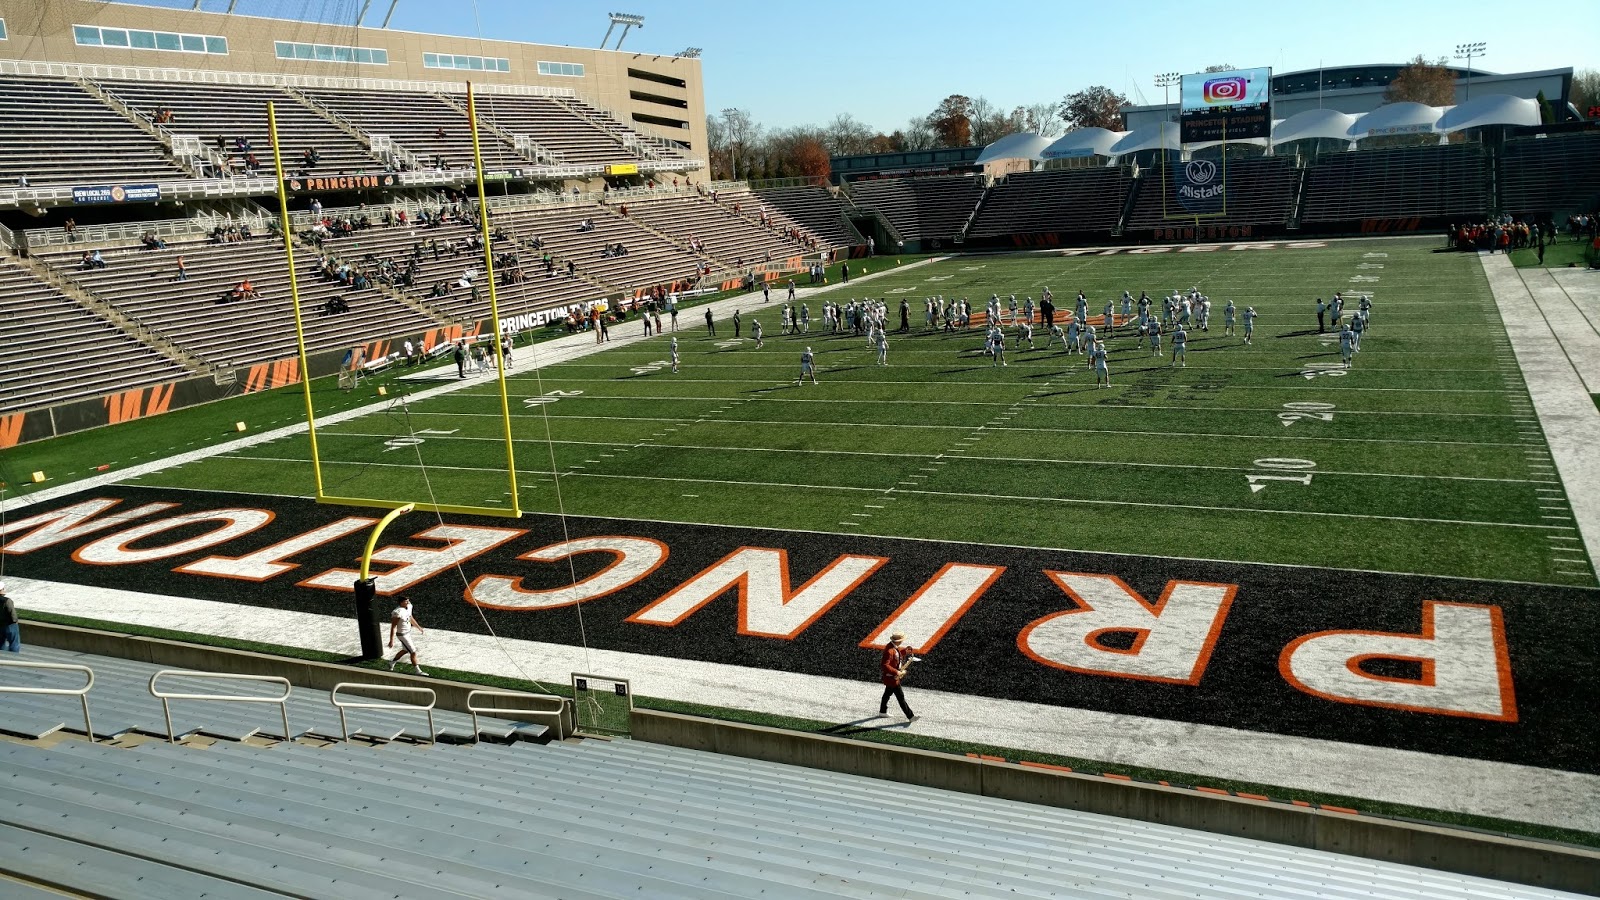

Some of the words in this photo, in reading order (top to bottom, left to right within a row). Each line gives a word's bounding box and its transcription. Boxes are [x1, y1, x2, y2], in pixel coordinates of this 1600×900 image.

[1230, 115, 1265, 125] STADIUM
[306, 175, 379, 190] PRINCETON
[1179, 184, 1224, 199] Allstate
[1153, 225, 1252, 240] PRINCETON
[498, 307, 570, 335] PRINCETON
[570, 297, 609, 316] TERS
[523, 390, 585, 404] 20
[1277, 402, 1336, 421] 20
[383, 428, 460, 446] 10
[1245, 457, 1317, 486] 10
[0, 496, 1519, 723] PRINCETON
[578, 680, 586, 689] 16
[616, 685, 624, 694] 15
